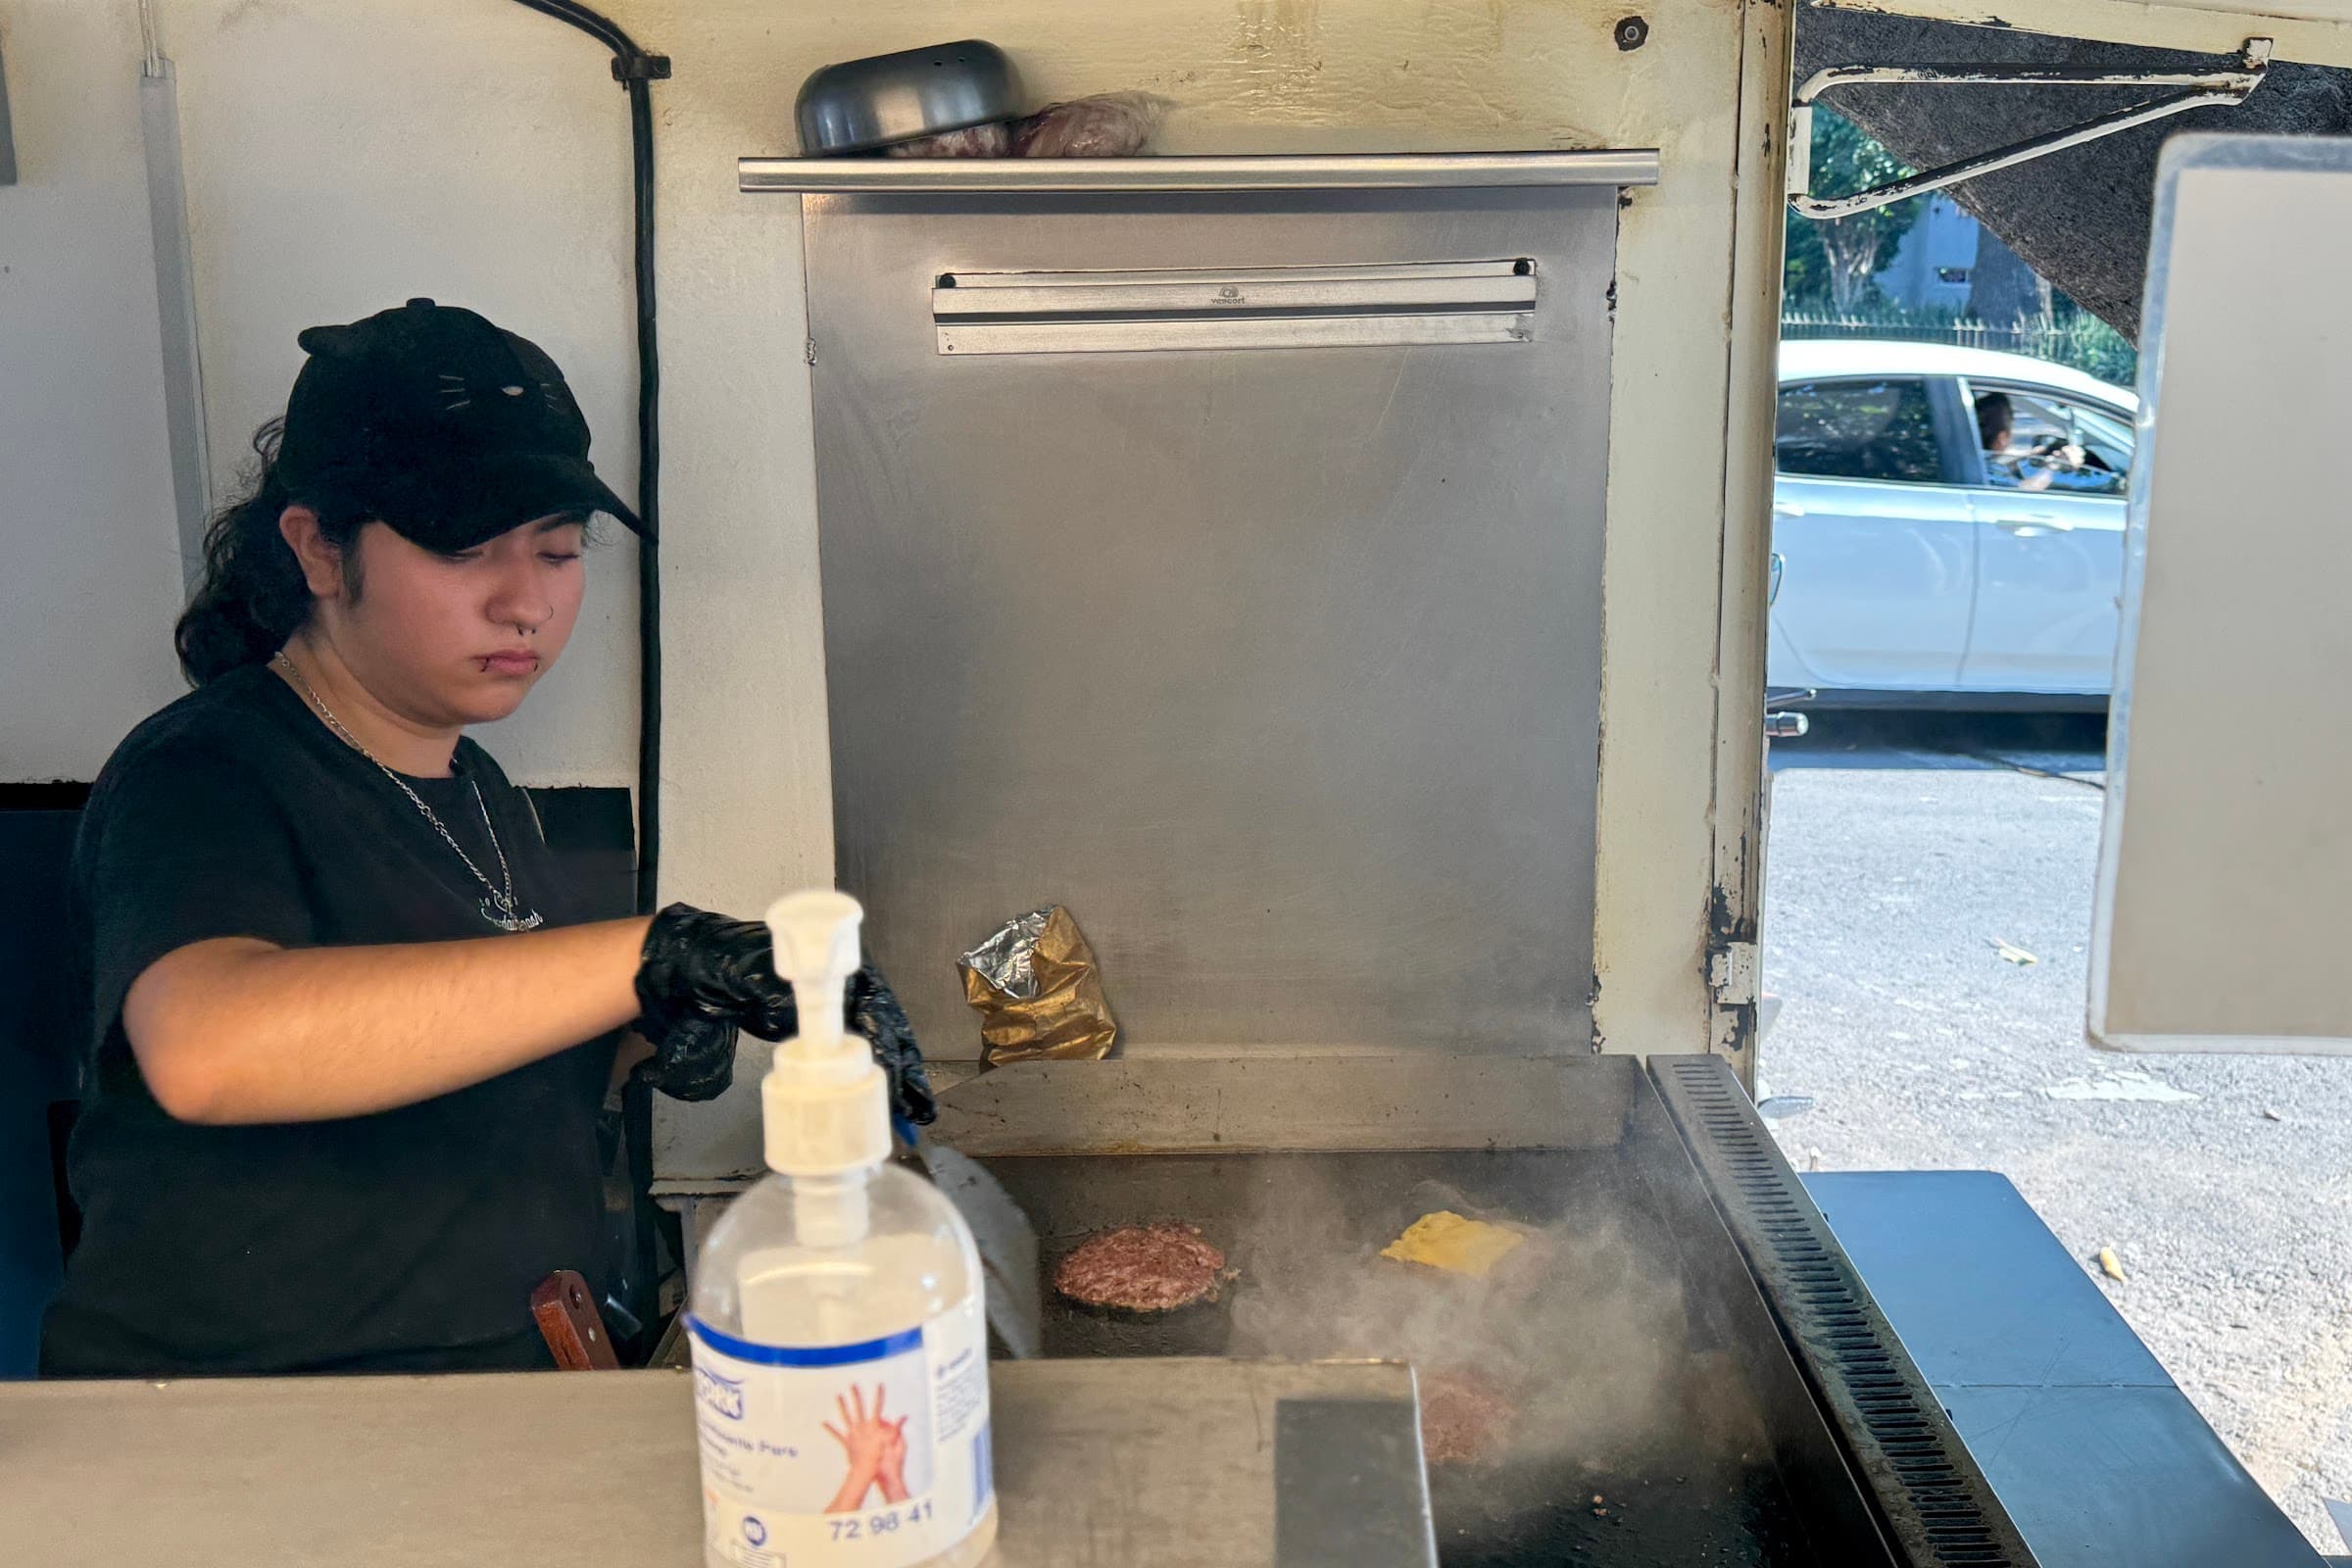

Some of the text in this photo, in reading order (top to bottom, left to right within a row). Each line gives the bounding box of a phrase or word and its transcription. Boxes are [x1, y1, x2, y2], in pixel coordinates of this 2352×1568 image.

[828, 1497, 933, 1542] 72 98 41
